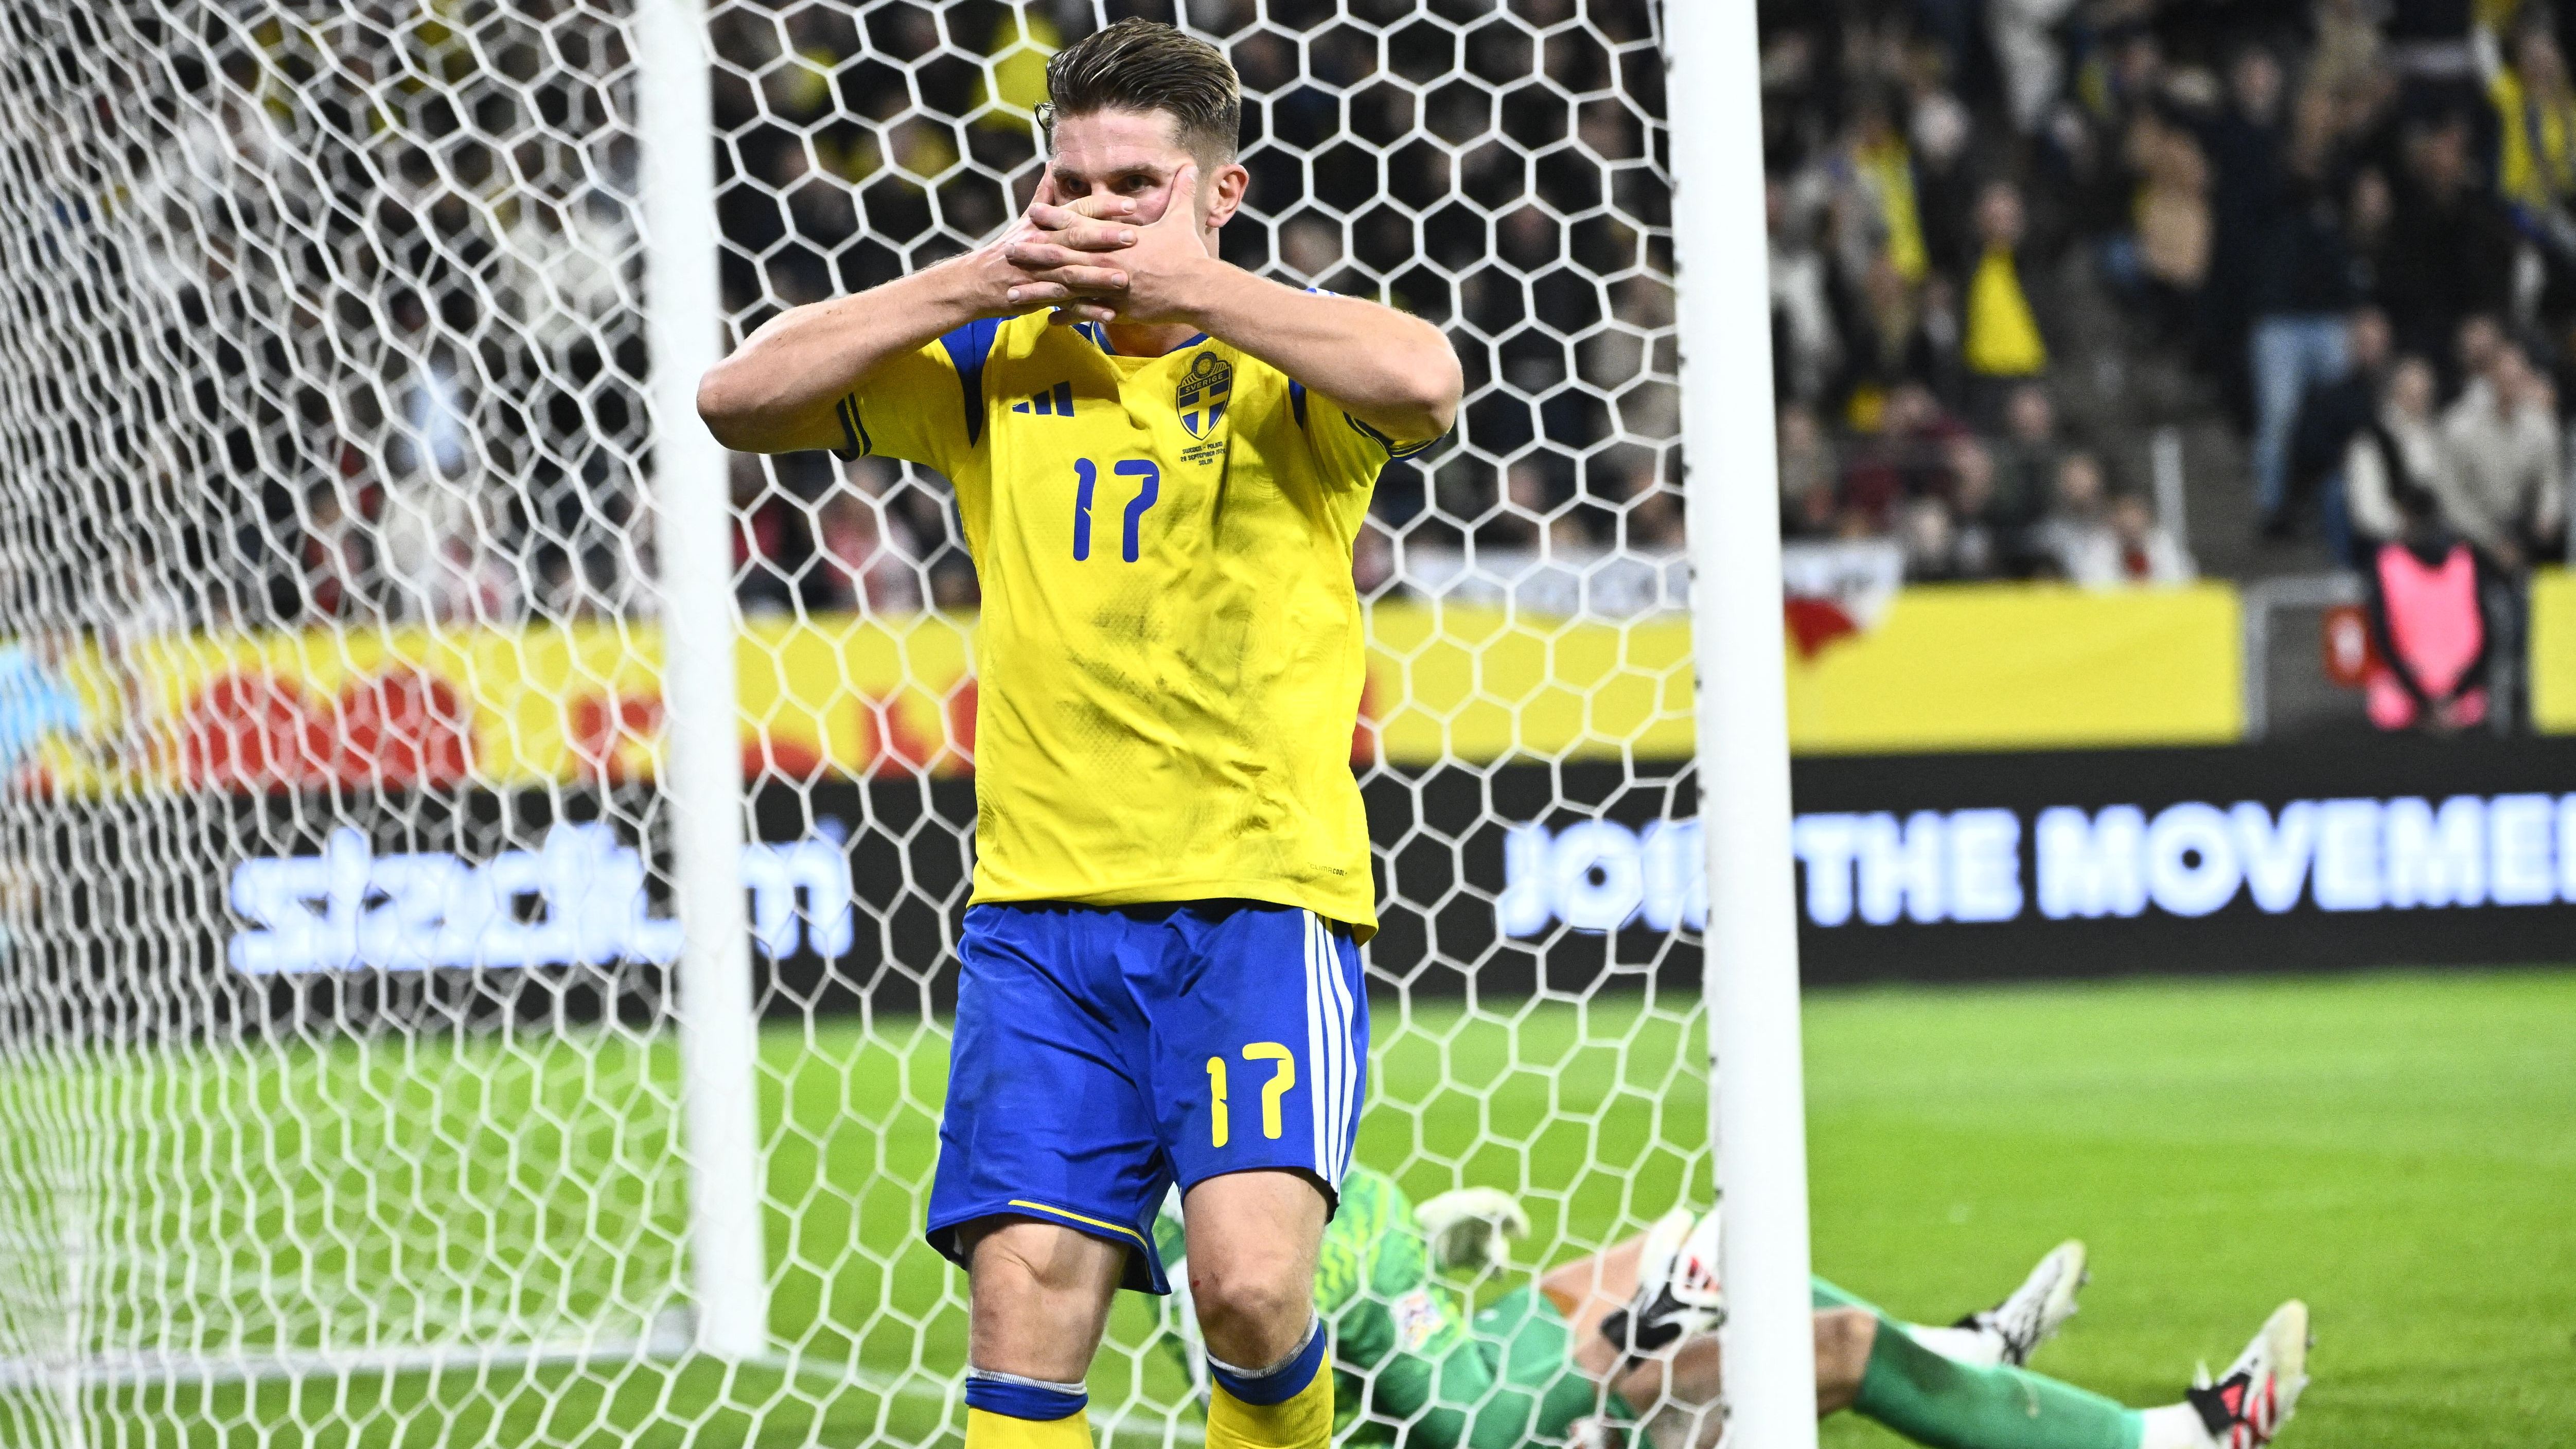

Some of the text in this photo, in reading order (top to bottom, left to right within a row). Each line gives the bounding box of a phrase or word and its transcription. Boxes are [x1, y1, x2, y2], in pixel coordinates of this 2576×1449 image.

[1185, 373, 1223, 393] SVERIGE
[1182, 446, 1202, 454] SWEDEN
[1207, 441, 1223, 450] POLAND
[1188, 450, 1215, 461] SEPTEMBER
[1073, 457, 1160, 563] 17
[1792, 807, 2023, 927] THE
[1206, 1041, 1295, 1148] 17
